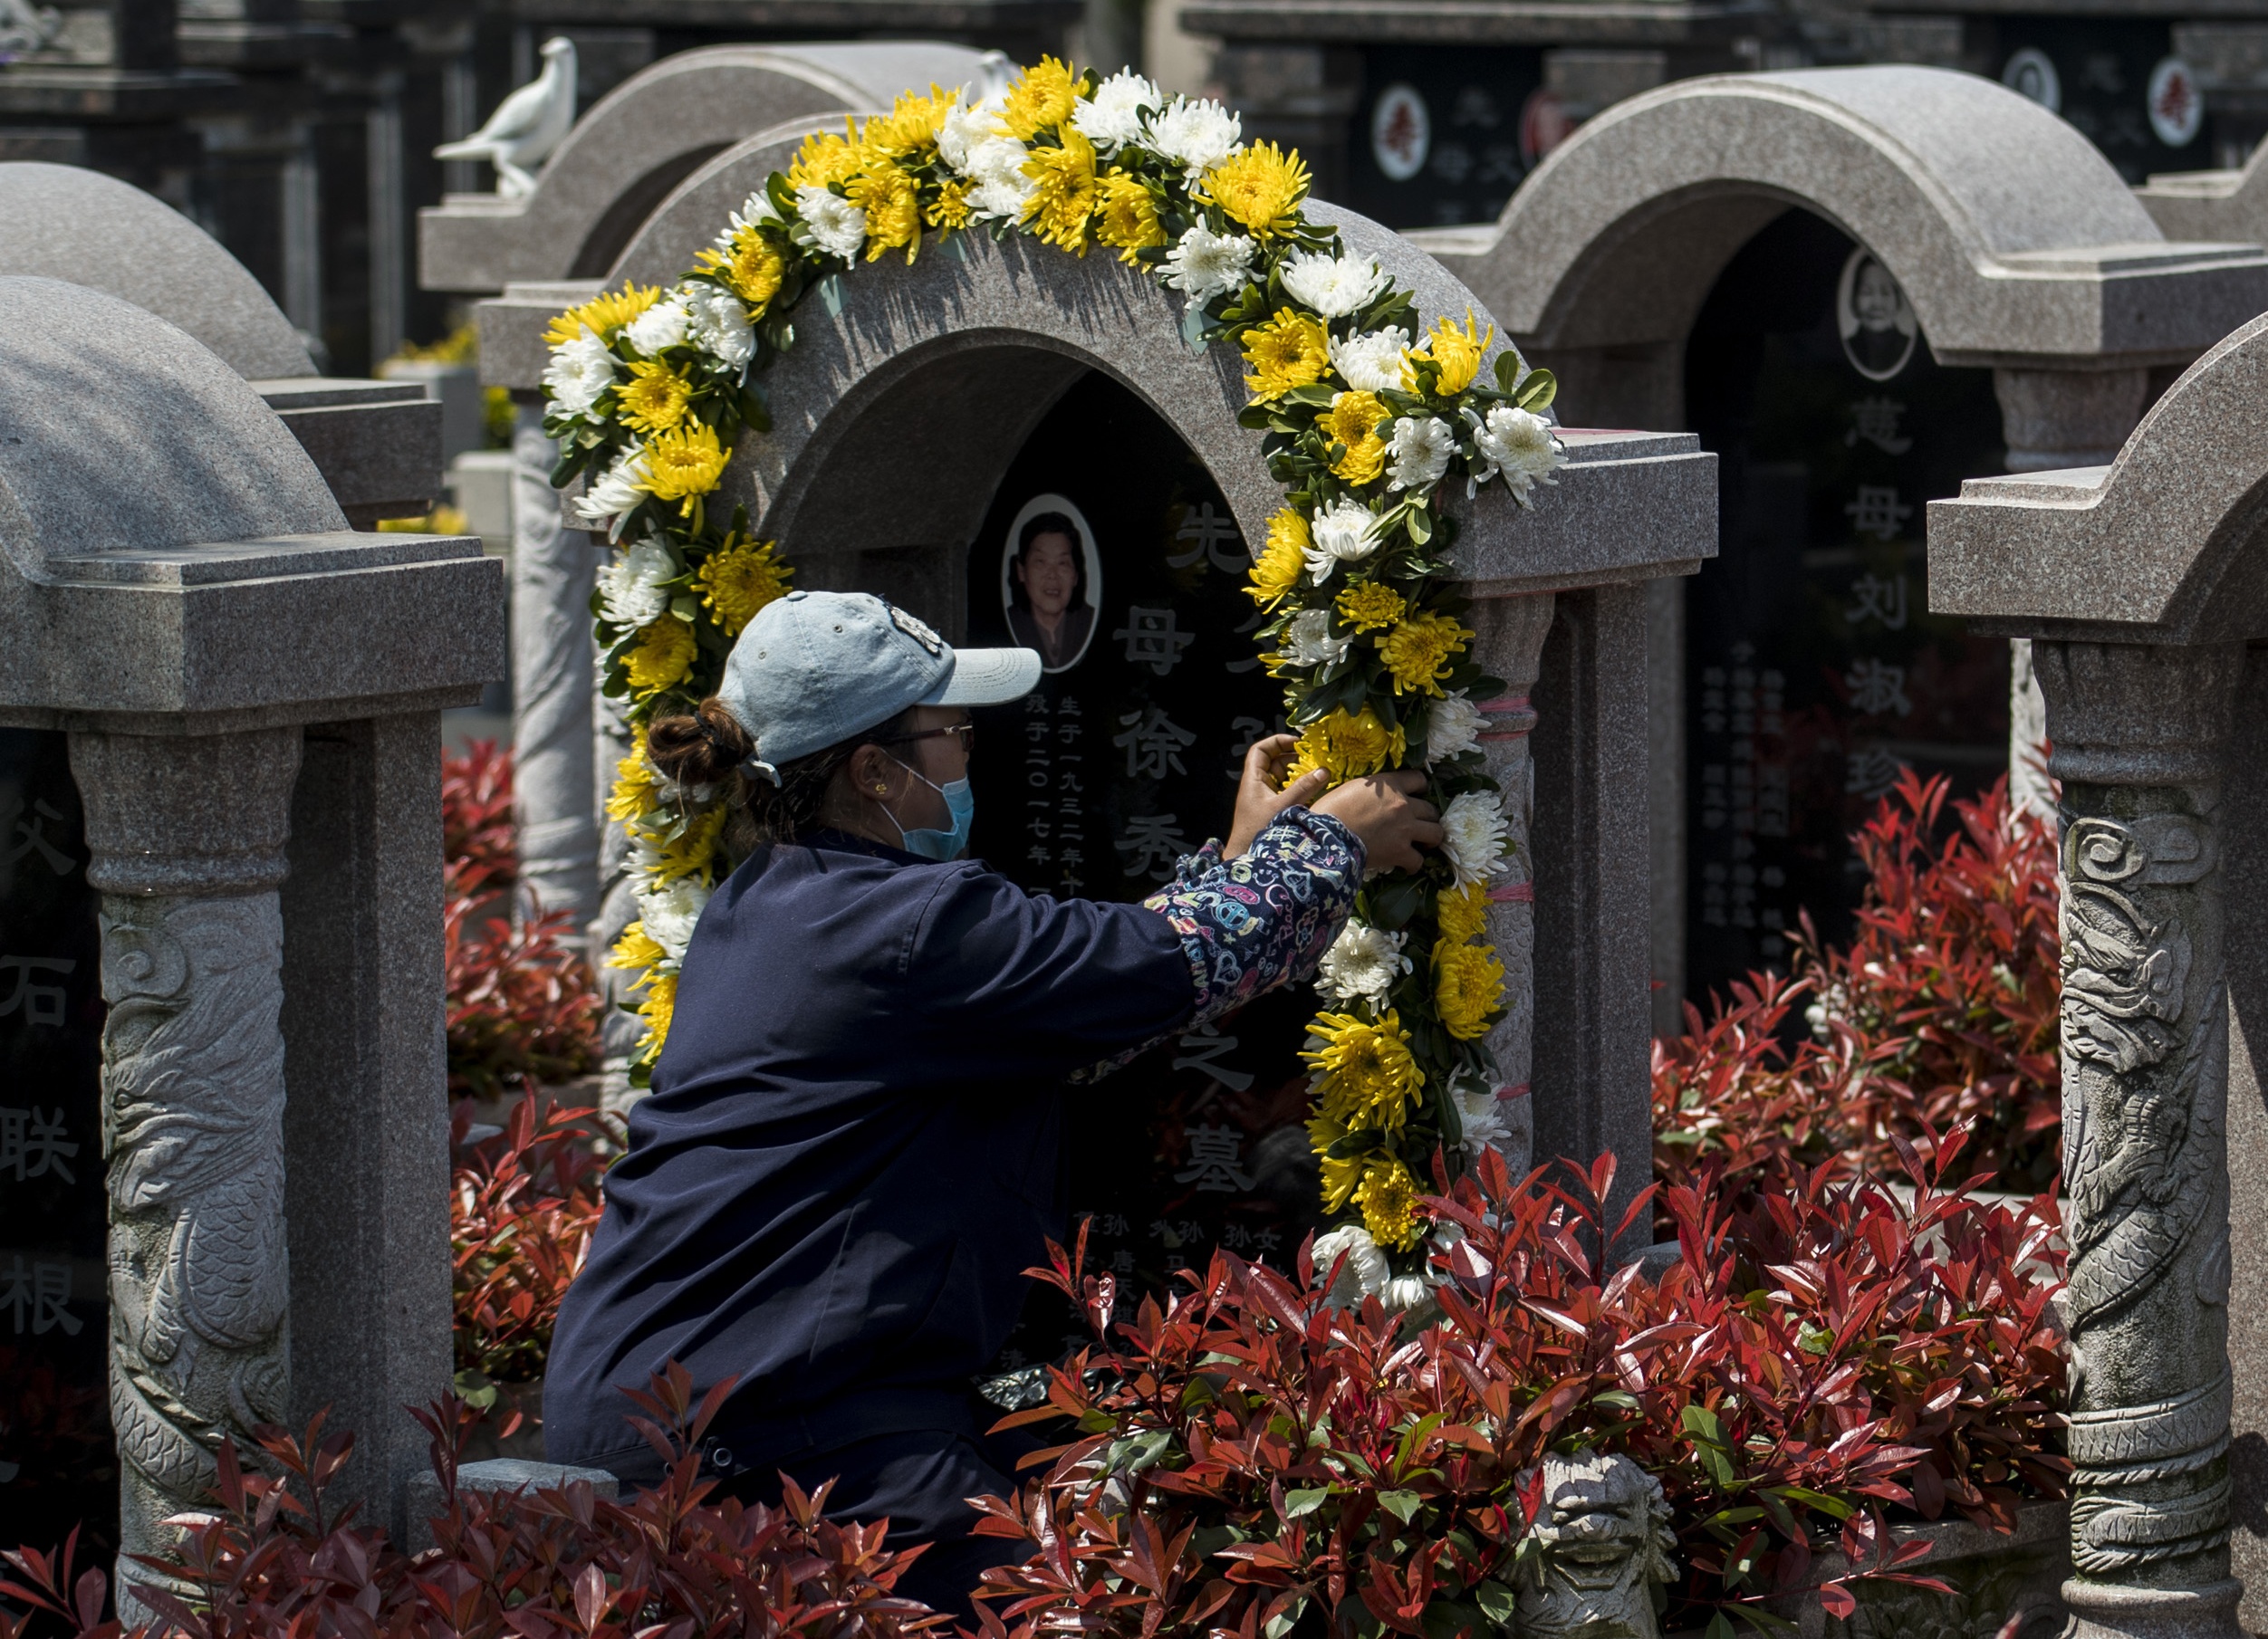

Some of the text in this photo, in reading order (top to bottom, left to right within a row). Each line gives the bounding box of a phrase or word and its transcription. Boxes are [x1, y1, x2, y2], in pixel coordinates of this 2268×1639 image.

[1165, 502, 1252, 575] 先
[1843, 397, 1915, 803] 慈母刘淑珍
